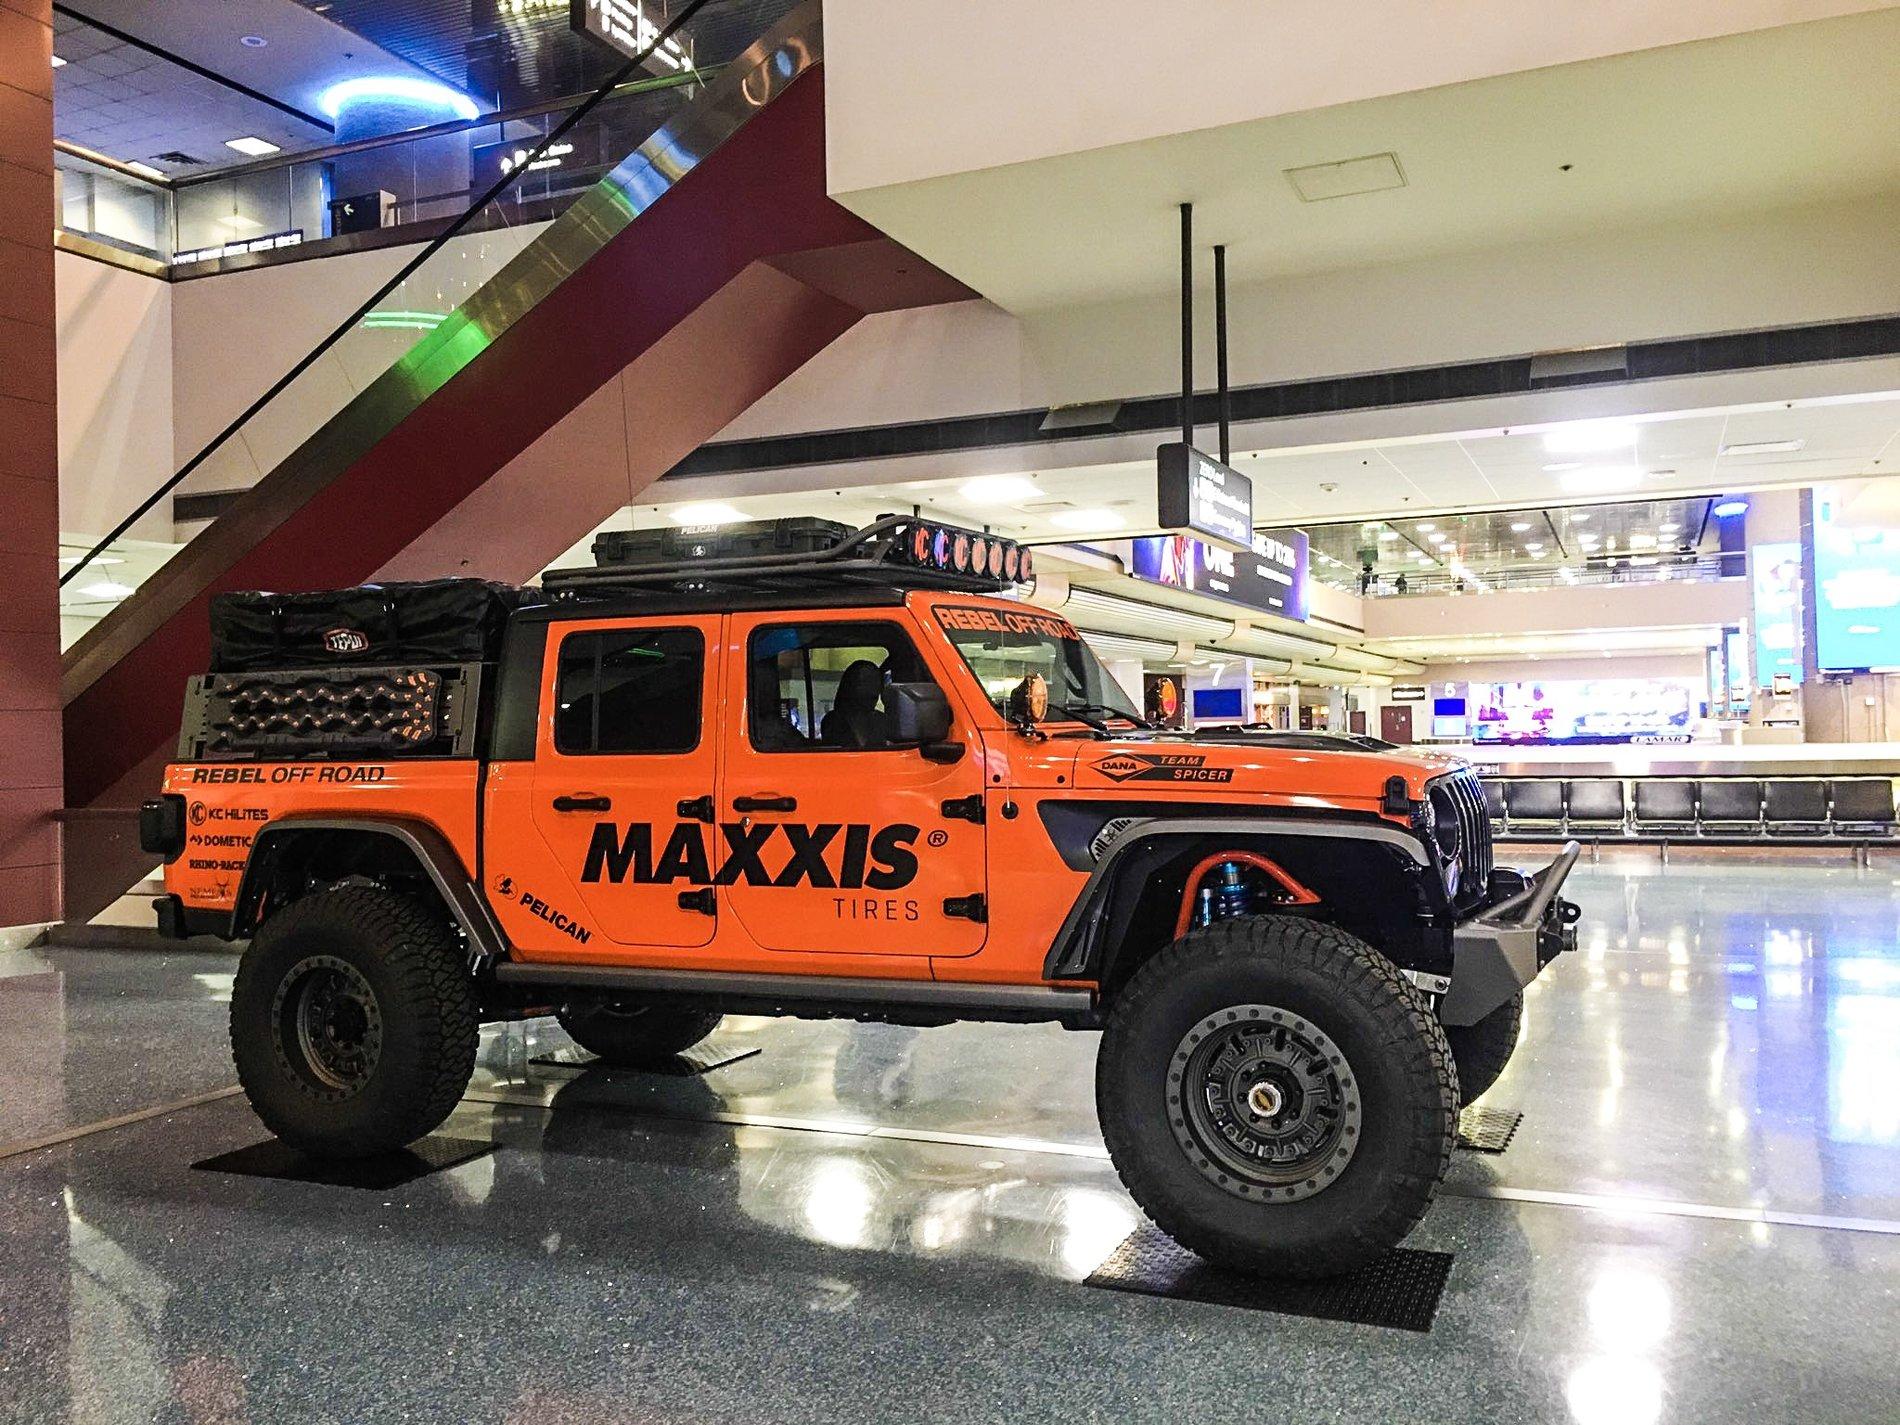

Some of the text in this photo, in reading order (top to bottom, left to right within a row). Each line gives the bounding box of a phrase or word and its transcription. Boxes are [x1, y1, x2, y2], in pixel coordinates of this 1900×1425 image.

[681, 525, 717, 535] PELICAN
[934, 607, 1081, 641] REBEL OFF ROAD
[1209, 663, 1226, 687] 7
[1635, 736, 1683, 744] LAMAR
[1101, 762, 1137, 770] DANA
[1160, 756, 1200, 765] TEAM
[192, 766, 385, 784] REBEL OFF ROAD
[1173, 769, 1227, 780] SPICER
[208, 808, 224, 820] KC
[204, 835, 252, 847] DOMETIC
[581, 823, 921, 891] MAXXIS
[833, 898, 919, 920] TIRES
[520, 892, 591, 944] PELICAN
